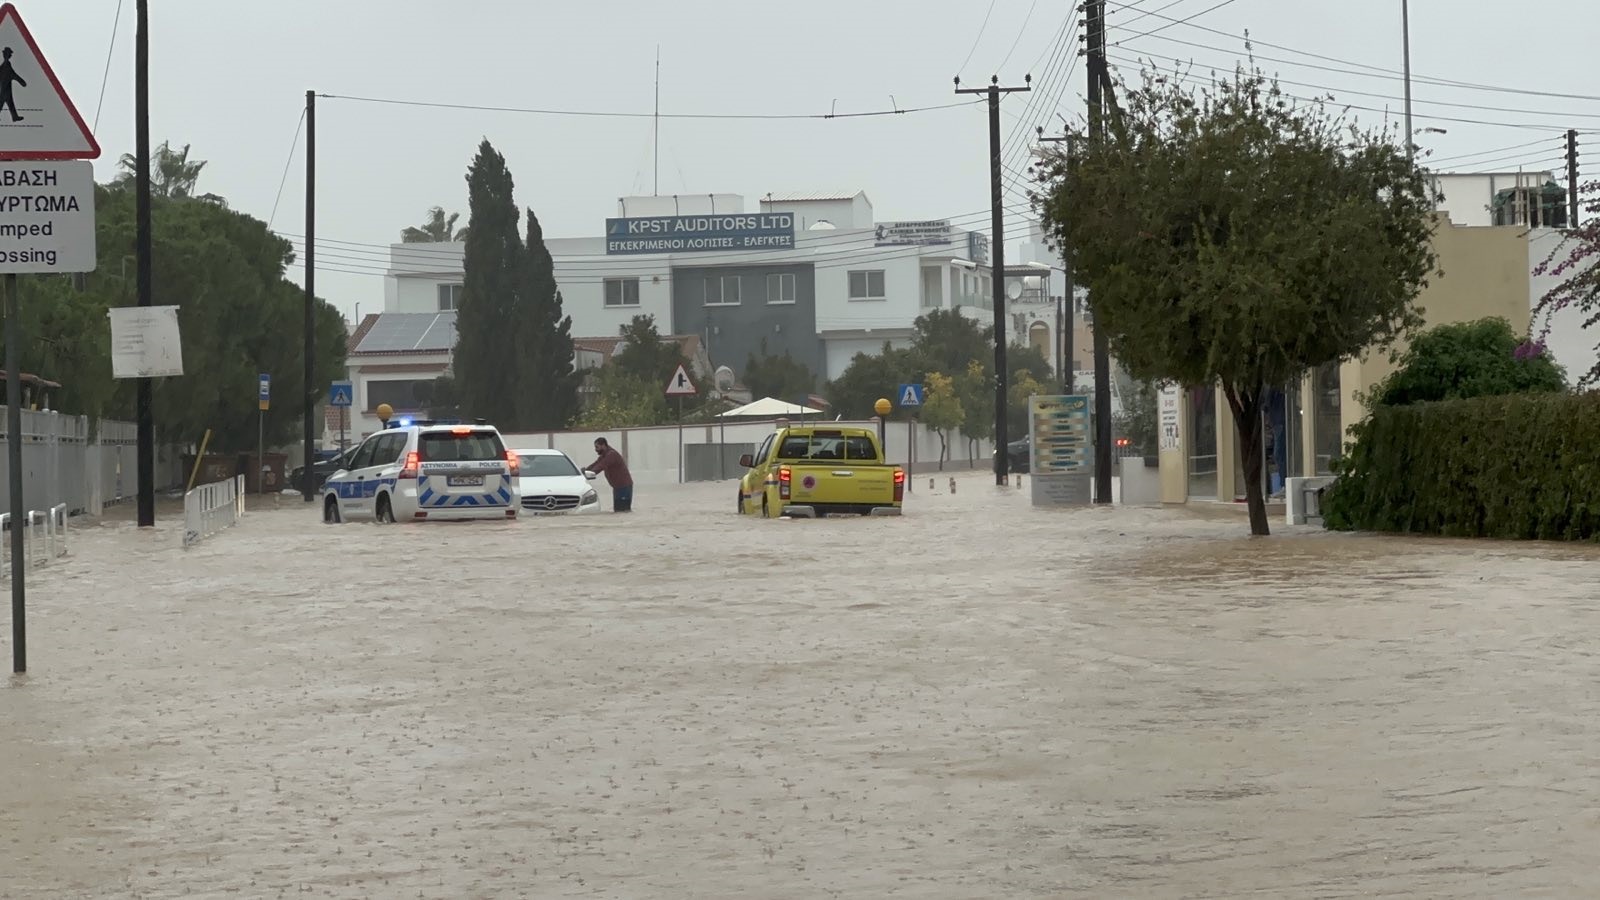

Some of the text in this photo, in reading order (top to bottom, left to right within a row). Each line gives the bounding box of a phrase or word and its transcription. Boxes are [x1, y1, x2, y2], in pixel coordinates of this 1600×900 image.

[0, 170, 57, 186] ΒΑΣΗ
[0, 221, 53, 239] mped
[628, 215, 791, 234] KPST AUDITORS LTD
[609, 239, 684, 251] ΕΓΚΕΚΡΙΜΕΝΟΙ
[686, 237, 734, 249] ΛΟΓΙΣΤΕΣ
[744, 235, 791, 247] ΕΛΕΓΚΤΕΣ
[0, 248, 57, 265] ossing
